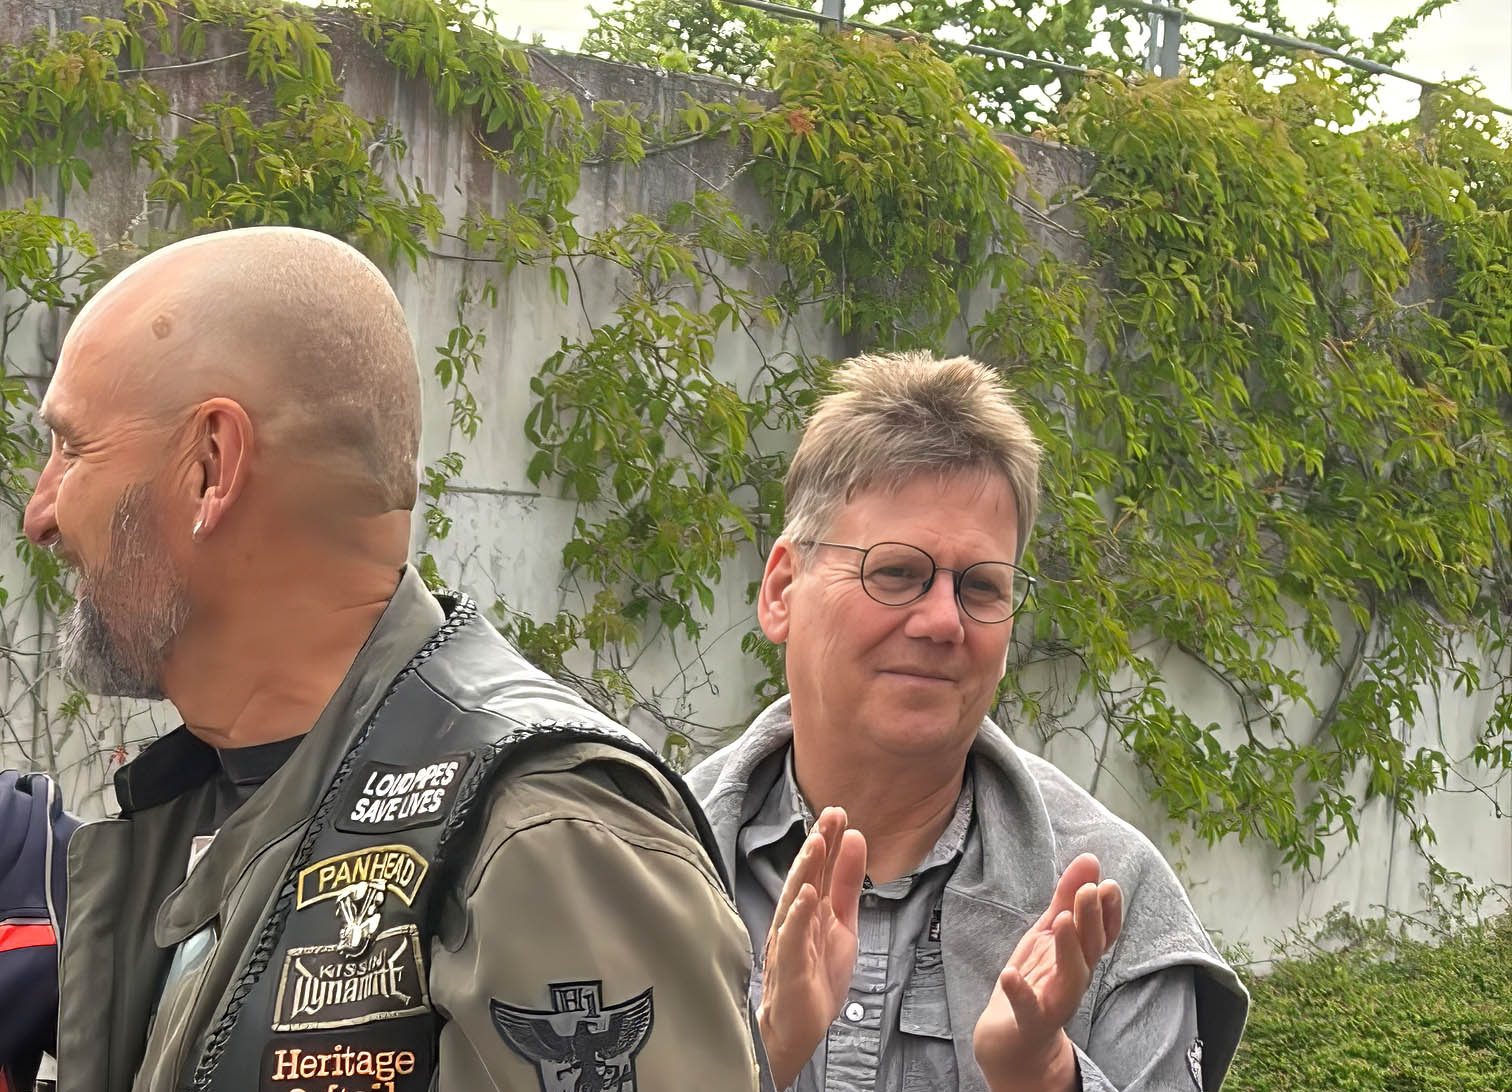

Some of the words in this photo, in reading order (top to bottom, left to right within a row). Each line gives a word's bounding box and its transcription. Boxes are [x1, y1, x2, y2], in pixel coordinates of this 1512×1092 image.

[351, 797, 402, 824] SAVE
[319, 852, 415, 893] PANHEAD
[272, 1044, 416, 1082] Heritage
